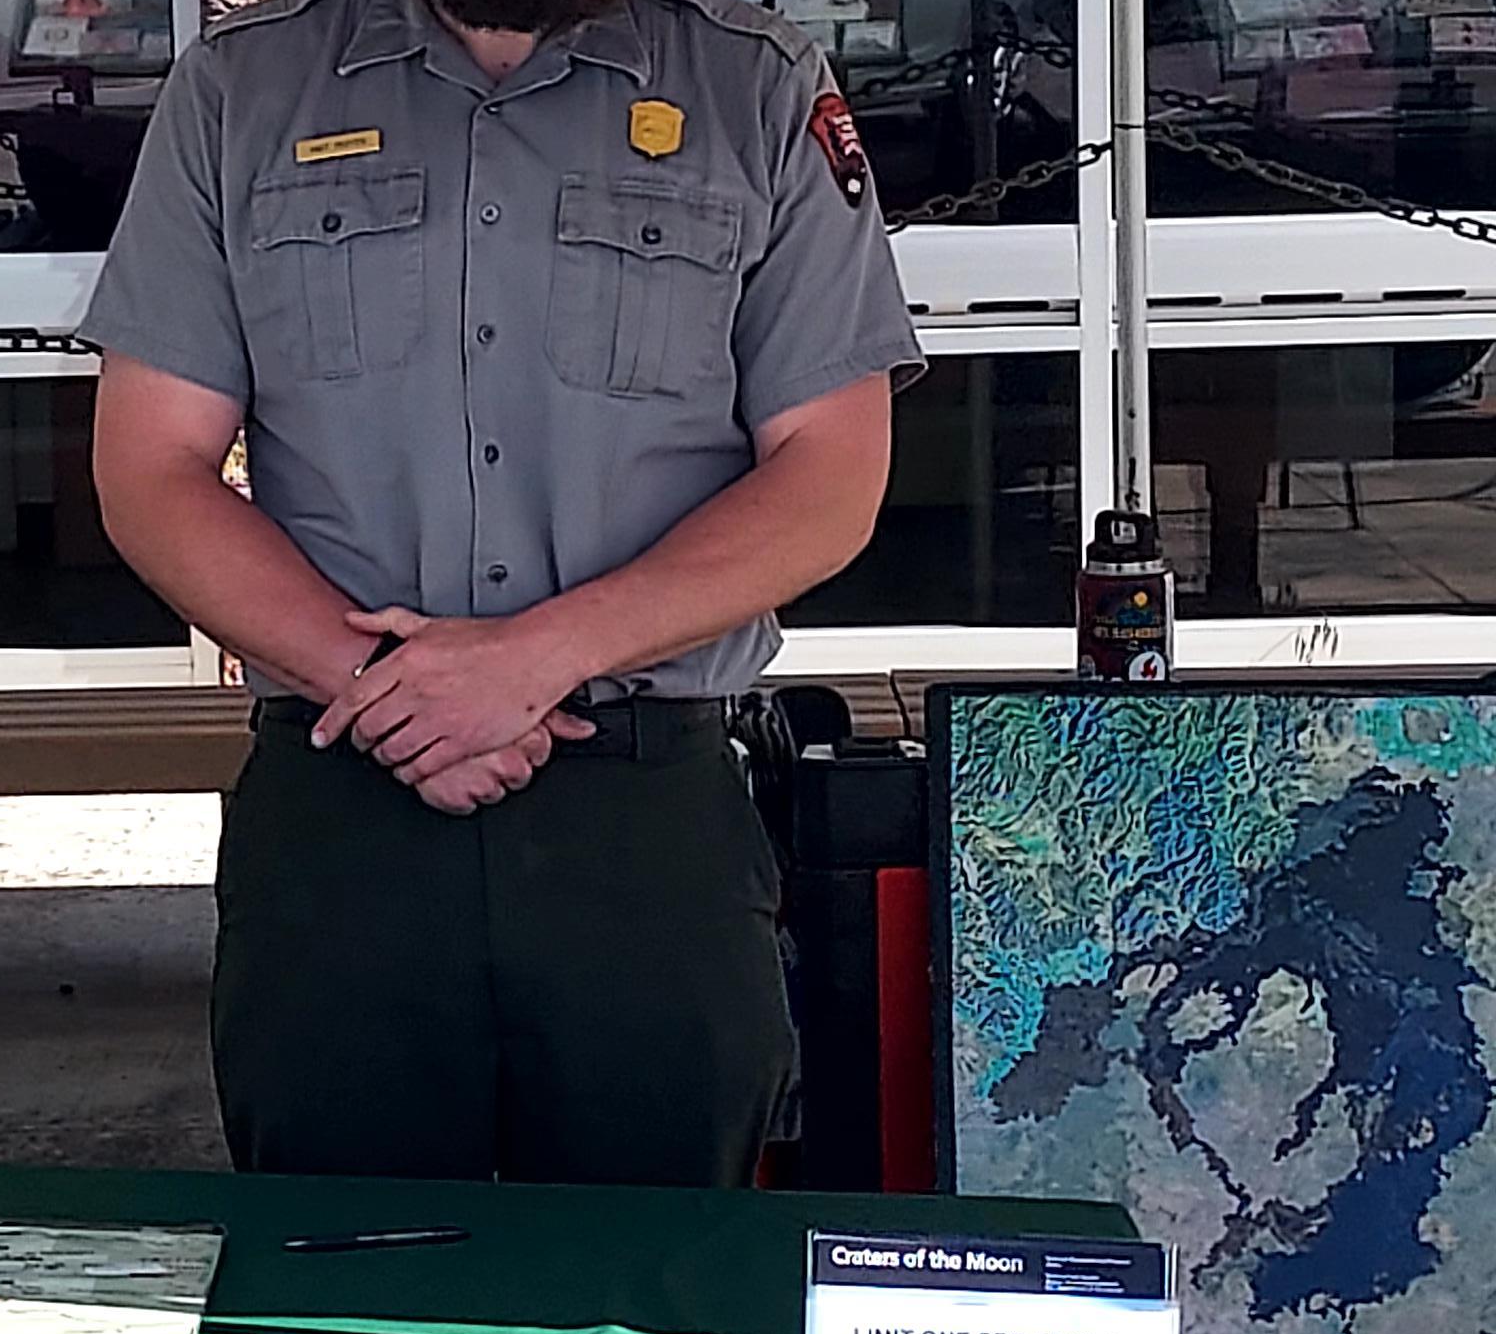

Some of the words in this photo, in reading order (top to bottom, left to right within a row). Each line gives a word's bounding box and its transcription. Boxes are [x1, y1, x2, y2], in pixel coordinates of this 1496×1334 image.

[831, 1245, 901, 1267] Craters
[903, 1248, 927, 1268] of
[929, 1249, 962, 1270] the
[965, 1251, 1024, 1273] Moon
